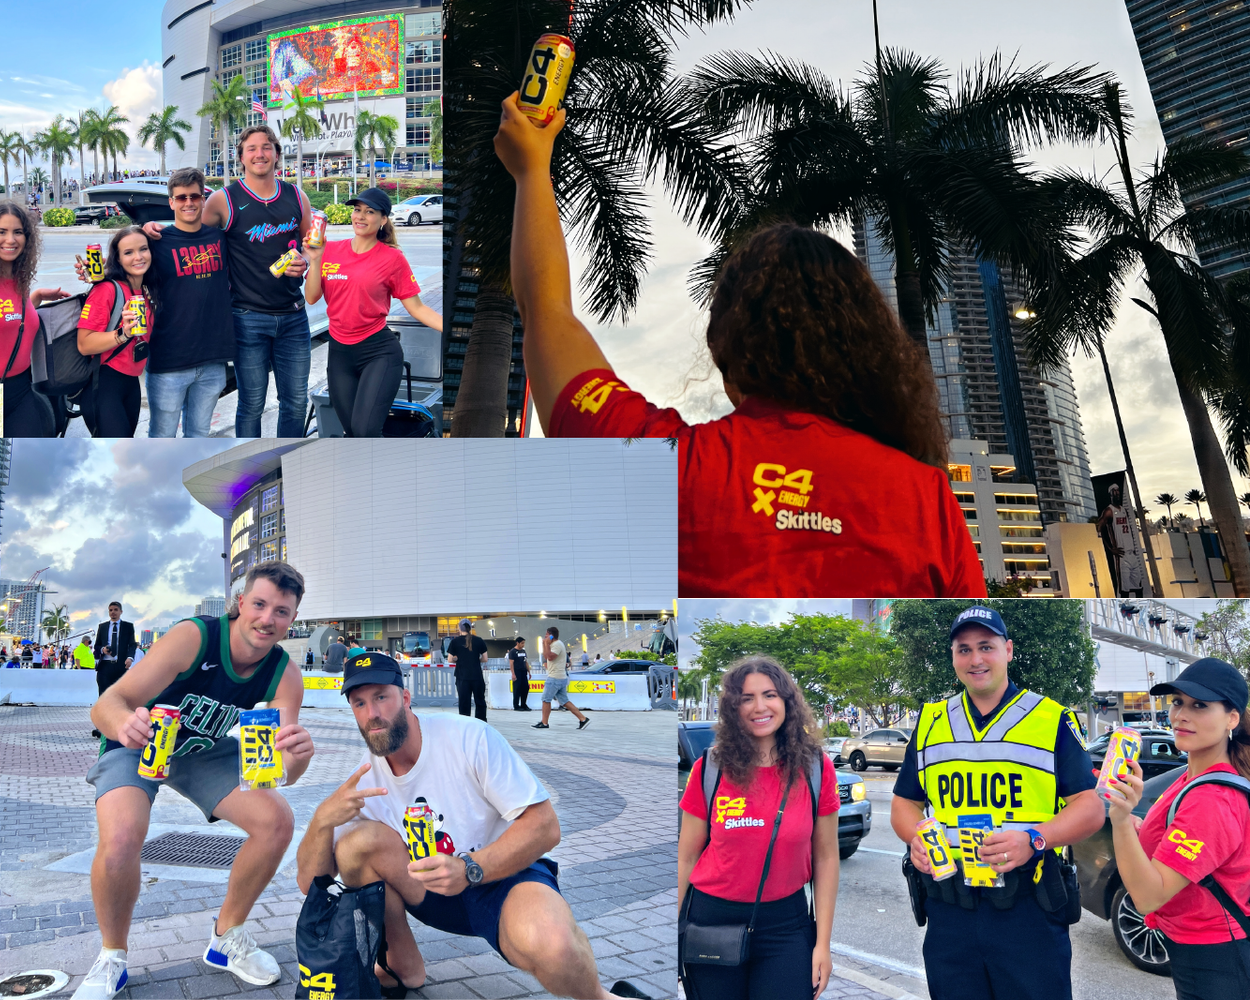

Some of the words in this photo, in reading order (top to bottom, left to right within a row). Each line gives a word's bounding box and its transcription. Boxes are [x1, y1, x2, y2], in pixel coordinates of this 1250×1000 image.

[519, 45, 559, 107] C4
[552, 57, 566, 87] ENERGY
[245, 216, 299, 244] Miami
[90, 249, 103, 276] C4
[752, 462, 815, 495] C4
[778, 489, 811, 508] ENERGY
[775, 508, 843, 536] Skittles
[1115, 516, 1128, 526] HEAT
[1122, 525, 1130, 534] 22
[957, 608, 993, 623] POLICE
[354, 656, 373, 668] C4
[159, 727, 169, 750] ENERGY
[257, 727, 274, 763] C4
[716, 796, 747, 810] C4
[937, 771, 1024, 810] POLICE
[724, 816, 765, 830] Skittles
[409, 819, 430, 862] C4
[922, 828, 949, 867] C4
[1167, 828, 1205, 855] C4
[1175, 845, 1199, 862] ENERGY
[309, 989, 336, 1000] ENERGY
